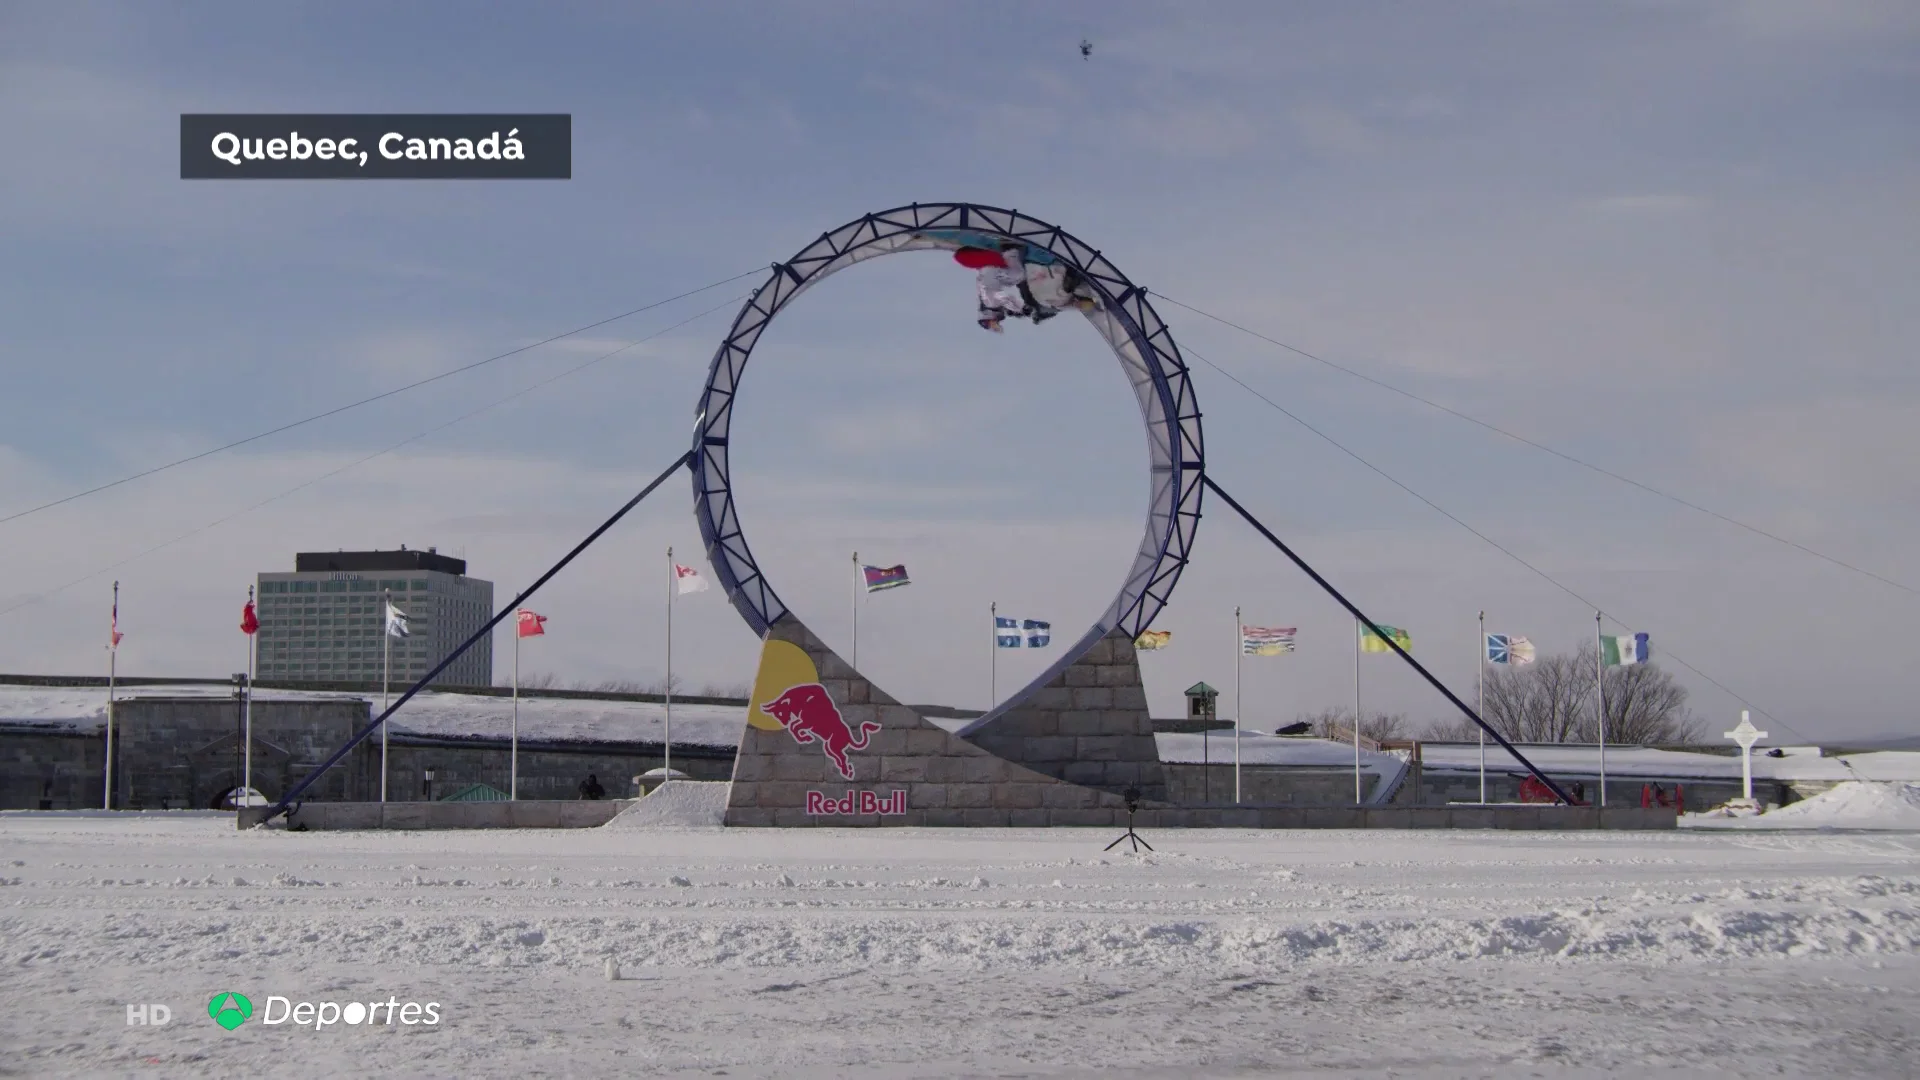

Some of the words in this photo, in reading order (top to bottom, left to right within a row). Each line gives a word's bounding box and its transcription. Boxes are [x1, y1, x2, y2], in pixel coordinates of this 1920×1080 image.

[328, 571, 359, 581] Hilton
[807, 790, 855, 815] Red
[860, 790, 907, 815] Bull
